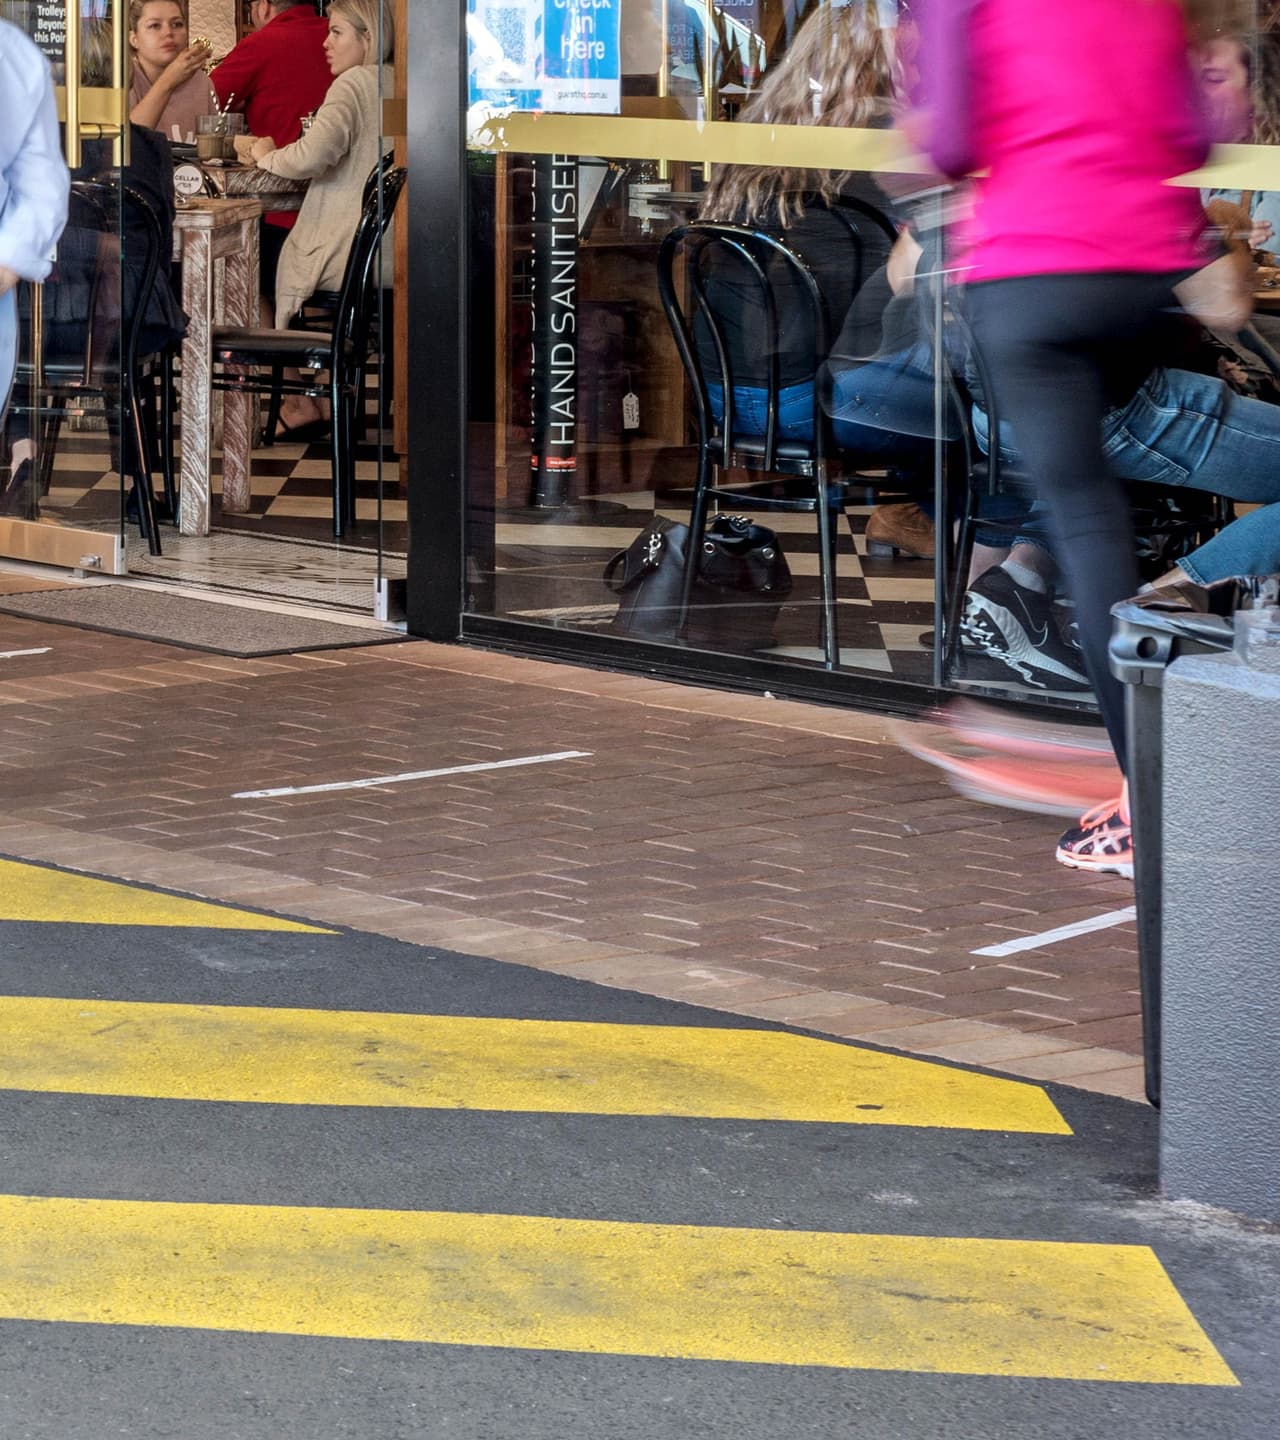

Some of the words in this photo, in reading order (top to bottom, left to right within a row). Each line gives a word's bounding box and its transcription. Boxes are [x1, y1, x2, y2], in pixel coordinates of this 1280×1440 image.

[575, 9, 593, 34] in
[34, 31, 49, 43] this
[560, 34, 606, 60] here
[550, 343, 576, 445] HAND
